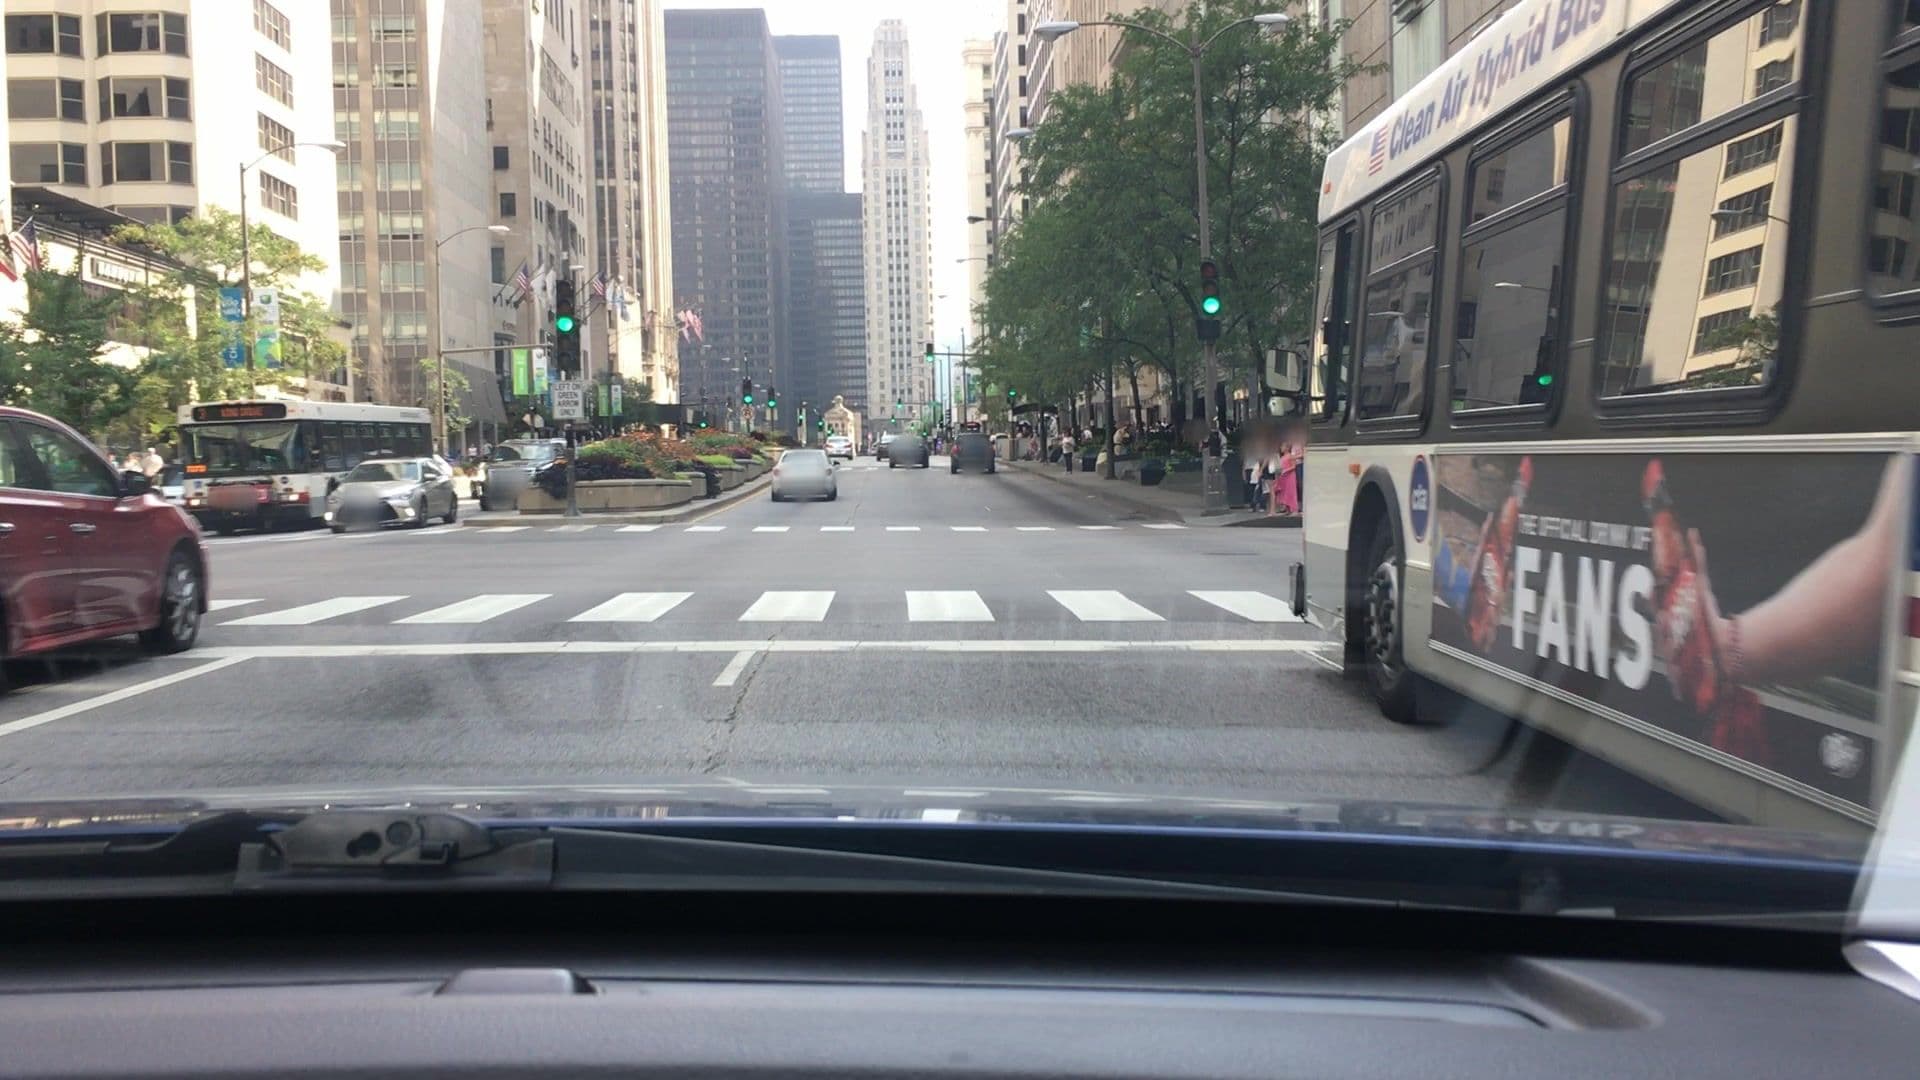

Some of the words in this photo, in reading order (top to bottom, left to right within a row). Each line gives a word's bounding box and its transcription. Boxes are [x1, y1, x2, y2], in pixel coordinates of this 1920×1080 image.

[1389, 102, 1435, 160] Clean
[1437, 70, 1469, 129] Air
[1470, 3, 1551, 108] Hybrid
[1551, 0, 1607, 51] Bus
[1512, 545, 1655, 690] FANS
